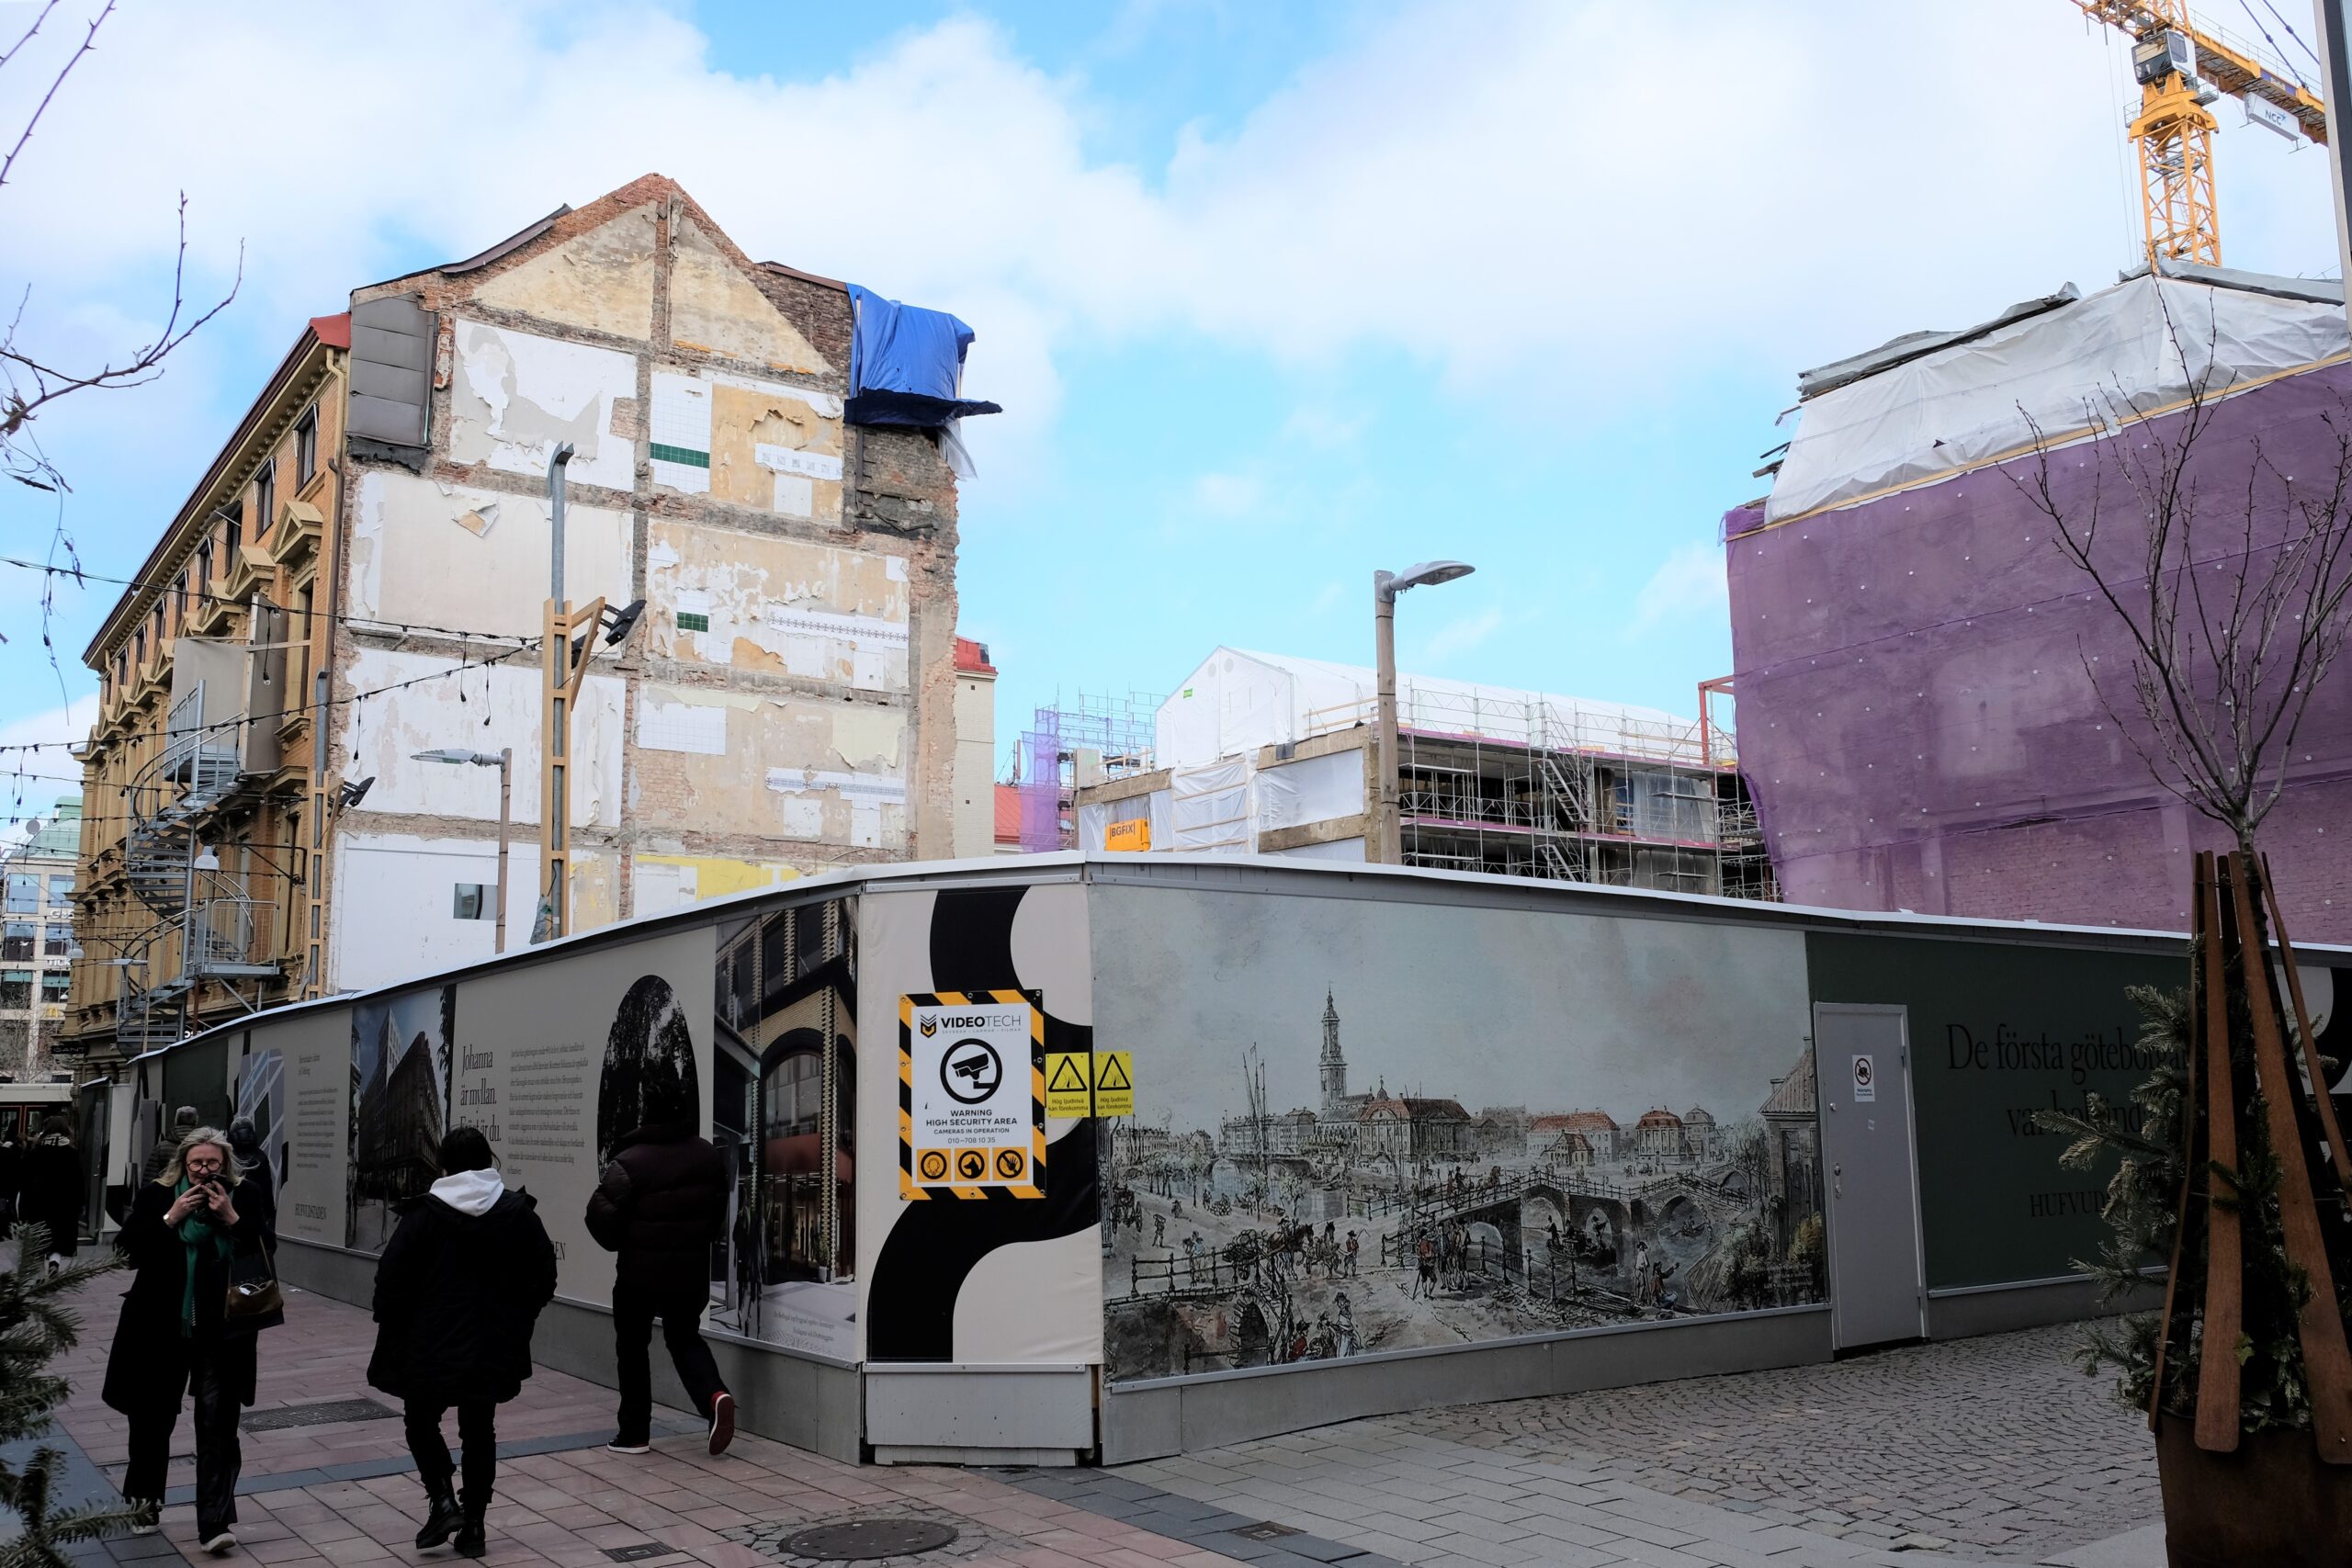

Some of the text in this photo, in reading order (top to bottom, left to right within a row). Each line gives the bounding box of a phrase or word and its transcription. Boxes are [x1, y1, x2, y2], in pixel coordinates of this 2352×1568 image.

[2265, 110, 2282, 126] NCC
[1111, 824, 1134, 837] BGFIX
[941, 1015, 1022, 1028] VIDEOTECH
[1945, 1023, 1989, 1069] De
[1995, 1023, 2064, 1070] första
[461, 1043, 493, 1077] Johanna
[460, 1085, 469, 1106] är
[469, 1077, 497, 1113] myllan.
[950, 1109, 992, 1117] WARNING
[950, 1118, 992, 1126] SECURITY
[993, 1117, 1018, 1125] AREA
[489, 1114, 502, 1142] du.
[2030, 1190, 2106, 1217] HUFVUD
